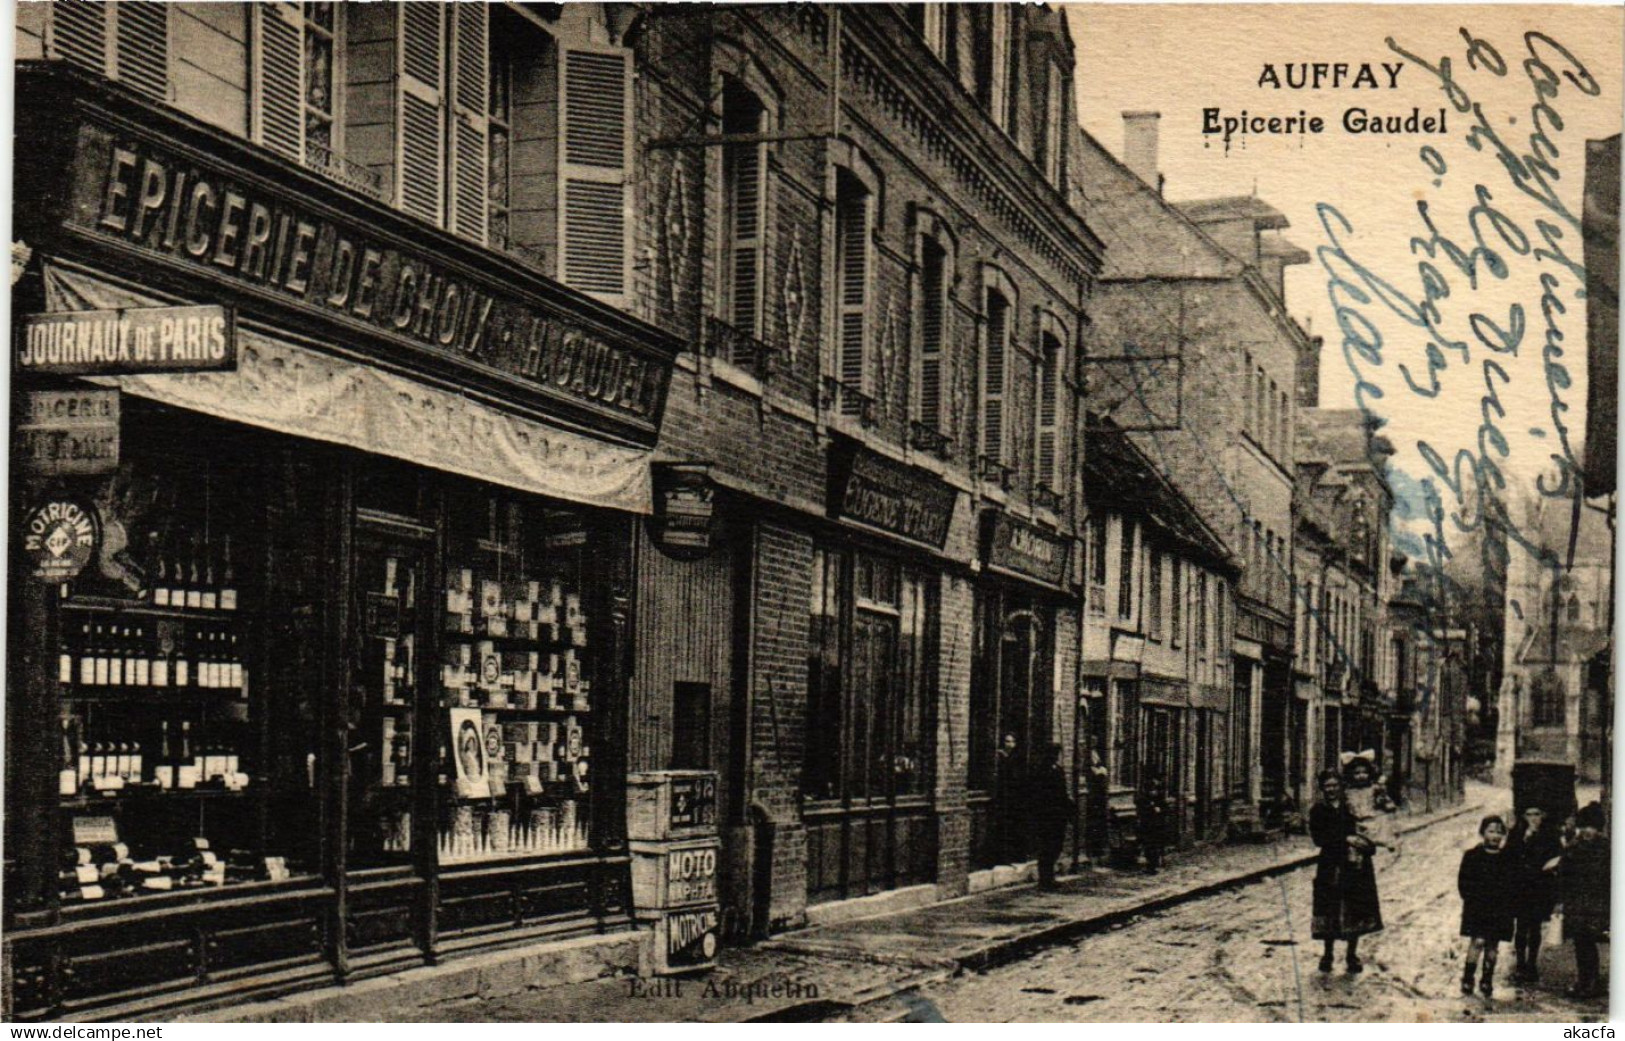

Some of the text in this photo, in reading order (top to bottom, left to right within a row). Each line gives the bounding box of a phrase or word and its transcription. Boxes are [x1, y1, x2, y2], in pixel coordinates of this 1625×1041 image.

[101, 147, 317, 294] EPICERIE
[326, 238, 381, 319] DE
[392, 263, 493, 353] CHOIX
[555, 330, 652, 415] GAUDEL
[20, 318, 130, 365] JOURNAUX
[160, 316, 225, 361] PARIS
[25, 502, 93, 550] MOTRICINE
[669, 849, 716, 880] MOTO
